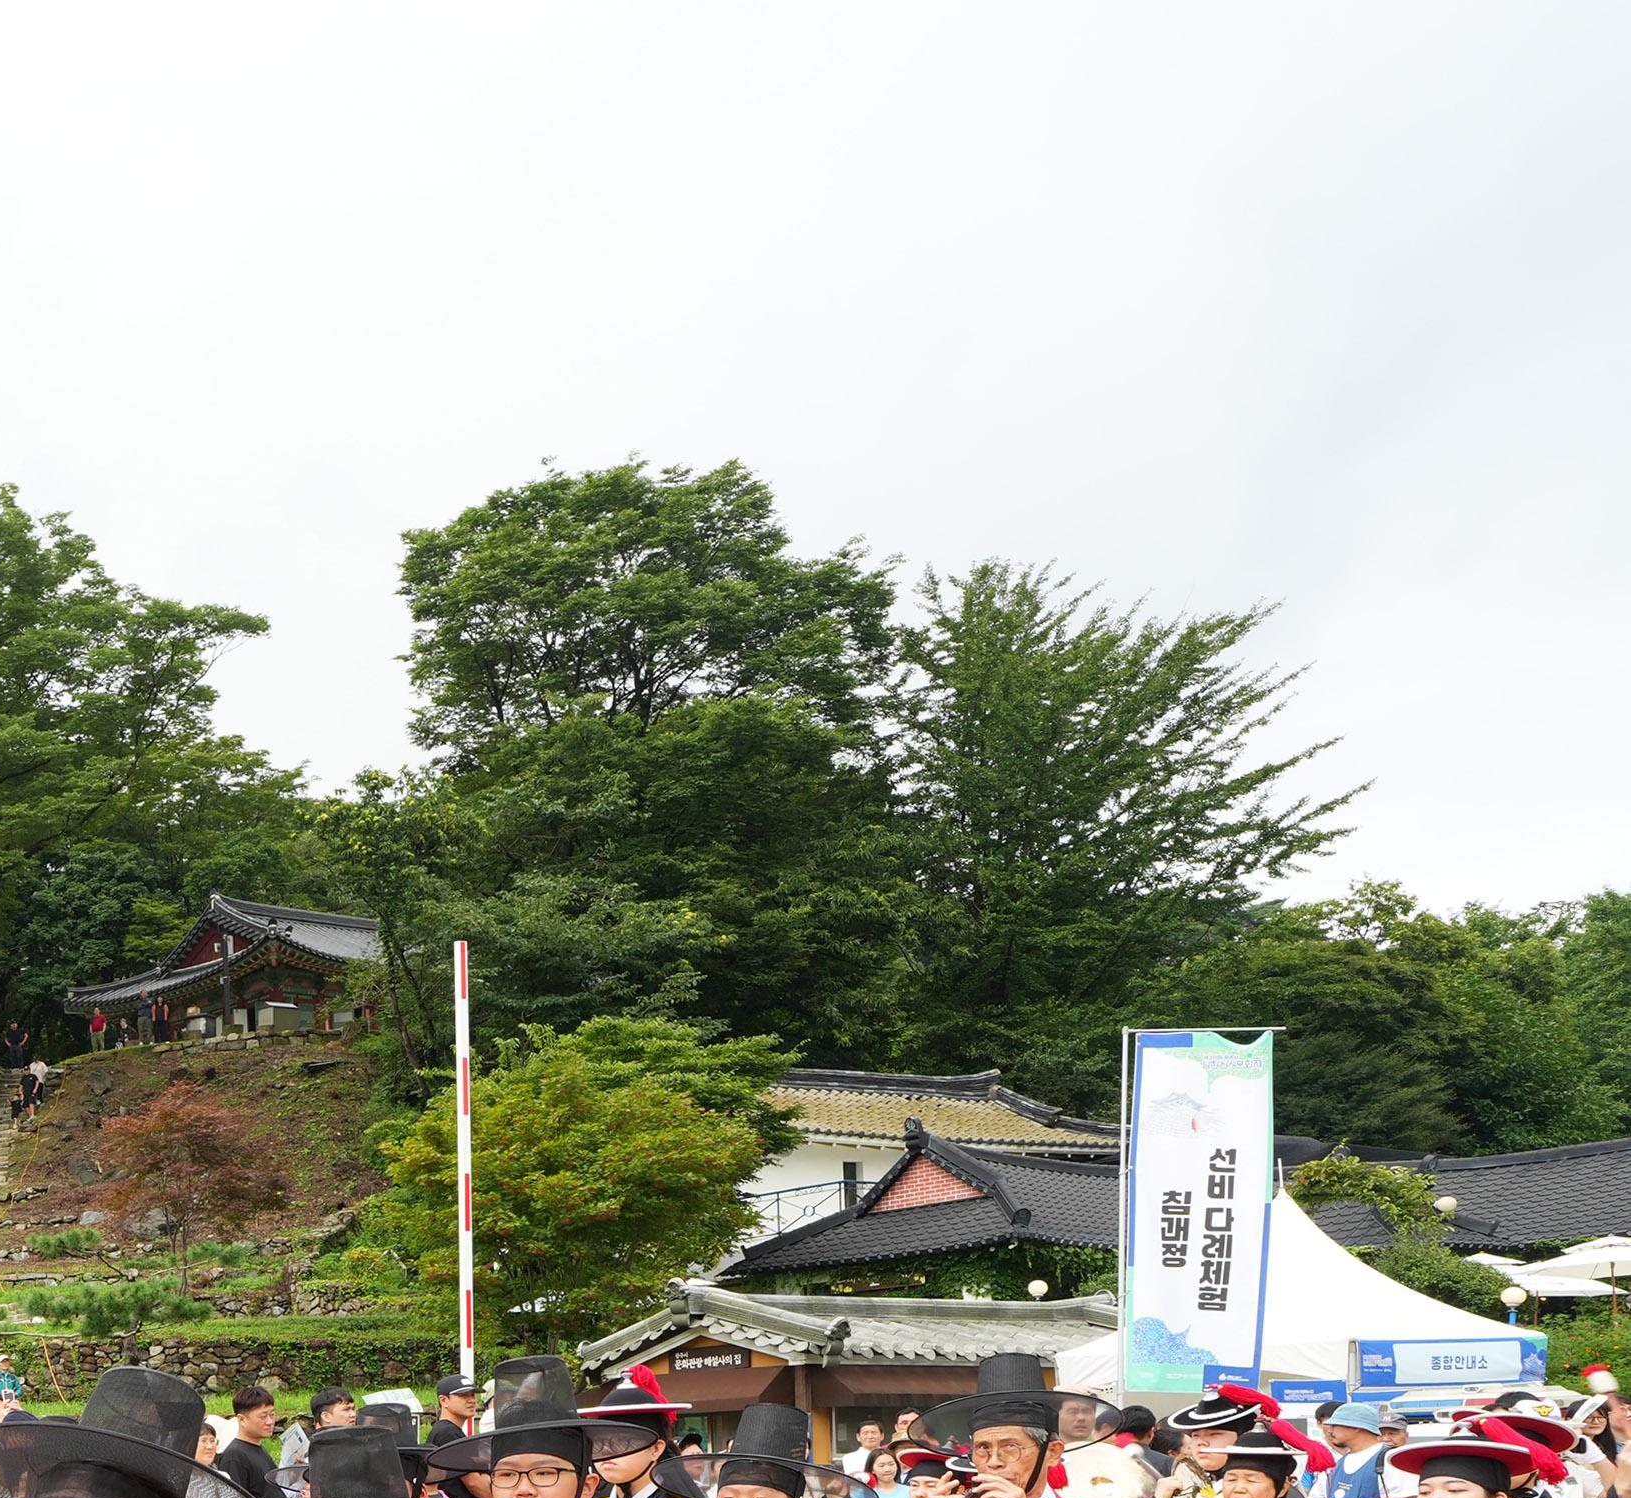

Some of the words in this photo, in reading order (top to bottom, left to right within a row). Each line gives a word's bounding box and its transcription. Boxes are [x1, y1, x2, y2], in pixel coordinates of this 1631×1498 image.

[1207, 1148, 1237, 1199] 선비
[1160, 1190, 1192, 1268] 침괘정
[1197, 1207, 1235, 1312] 다례체험
[675, 1357, 703, 1370] 문화관광
[733, 1353, 742, 1365] 집
[1431, 1355, 1488, 1371] 종합안내소
